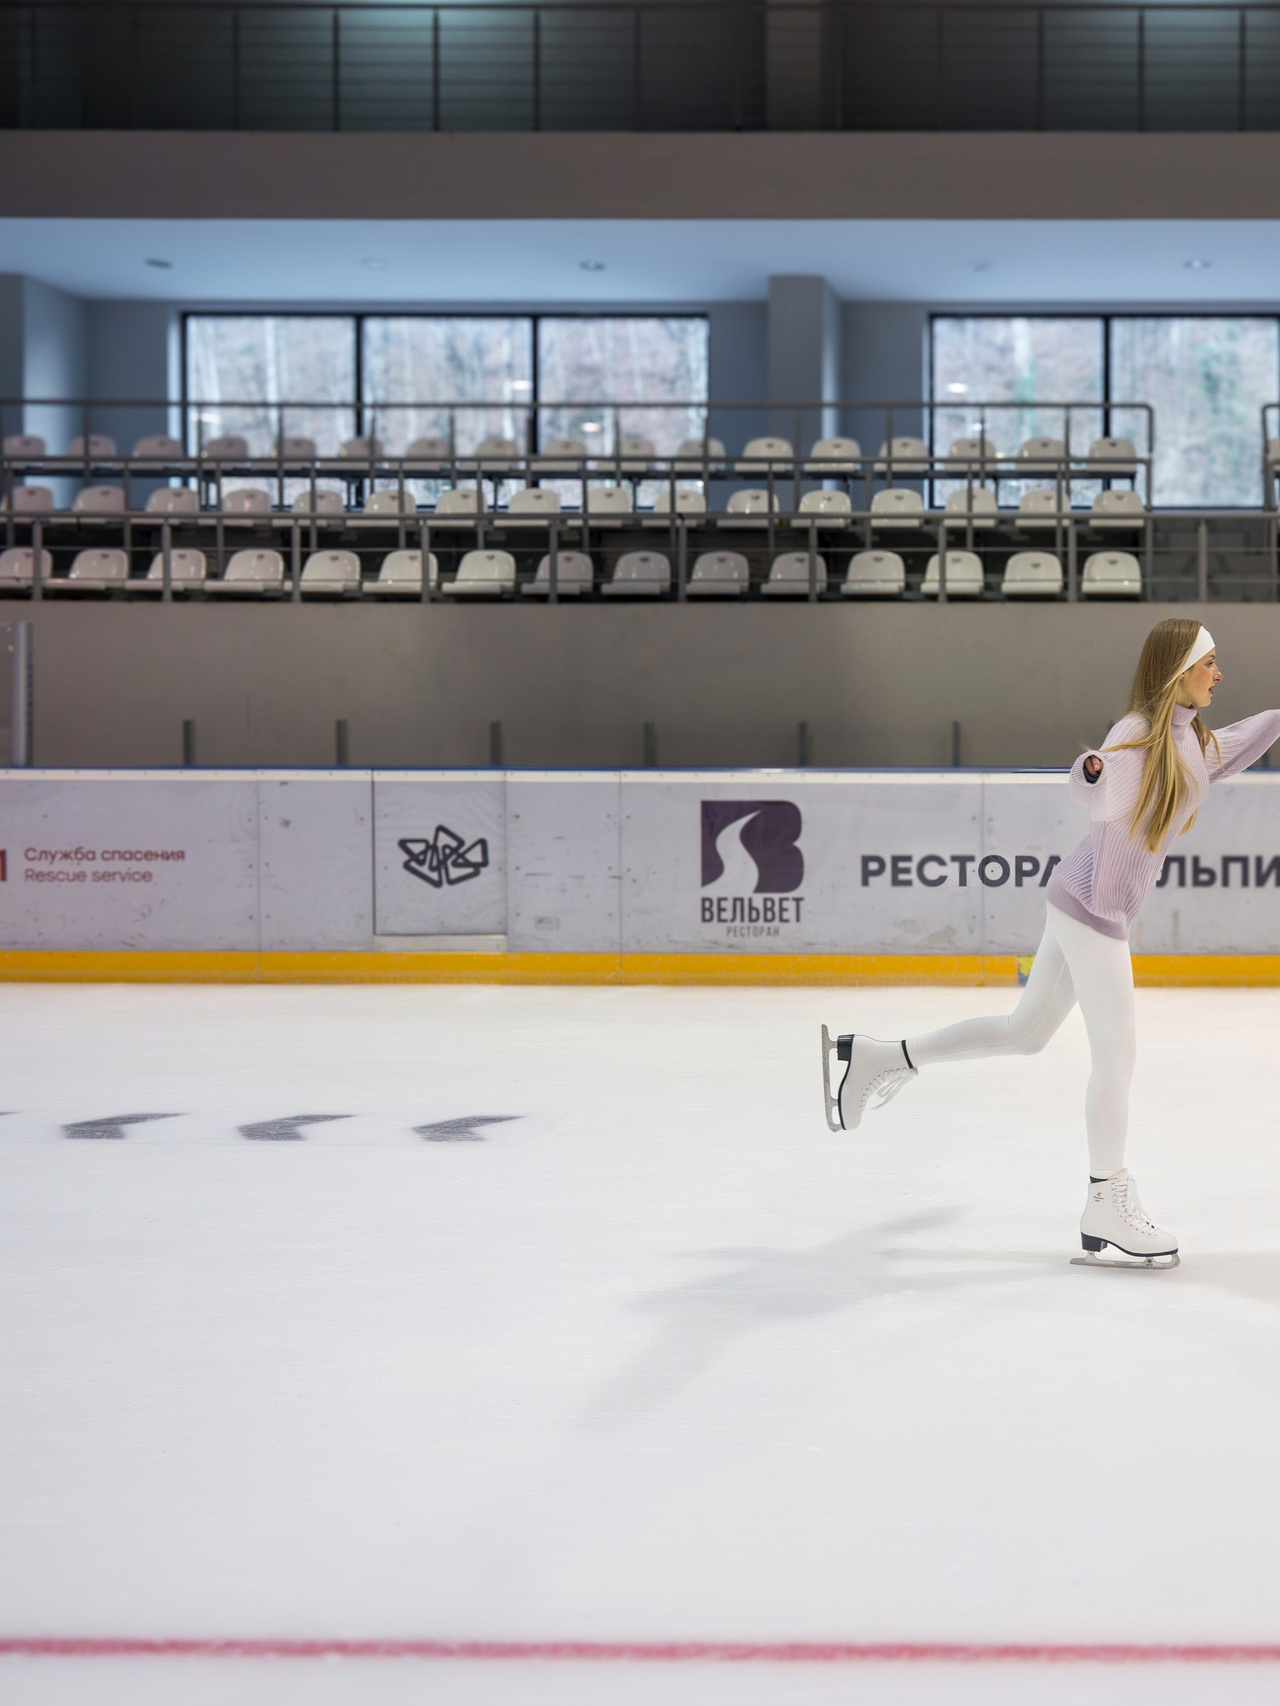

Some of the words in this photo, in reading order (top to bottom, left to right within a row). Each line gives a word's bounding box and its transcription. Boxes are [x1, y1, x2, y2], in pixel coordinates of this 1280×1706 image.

[24, 846, 96, 865] Служба
[101, 849, 186, 862] спасения
[24, 868, 87, 882] Rescue
[91, 867, 153, 882] service
[861, 854, 1062, 888] РЕСТОР
[701, 897, 805, 923] ВЕЛЬВЕТ
[726, 925, 781, 938] РЕСТОРАН
